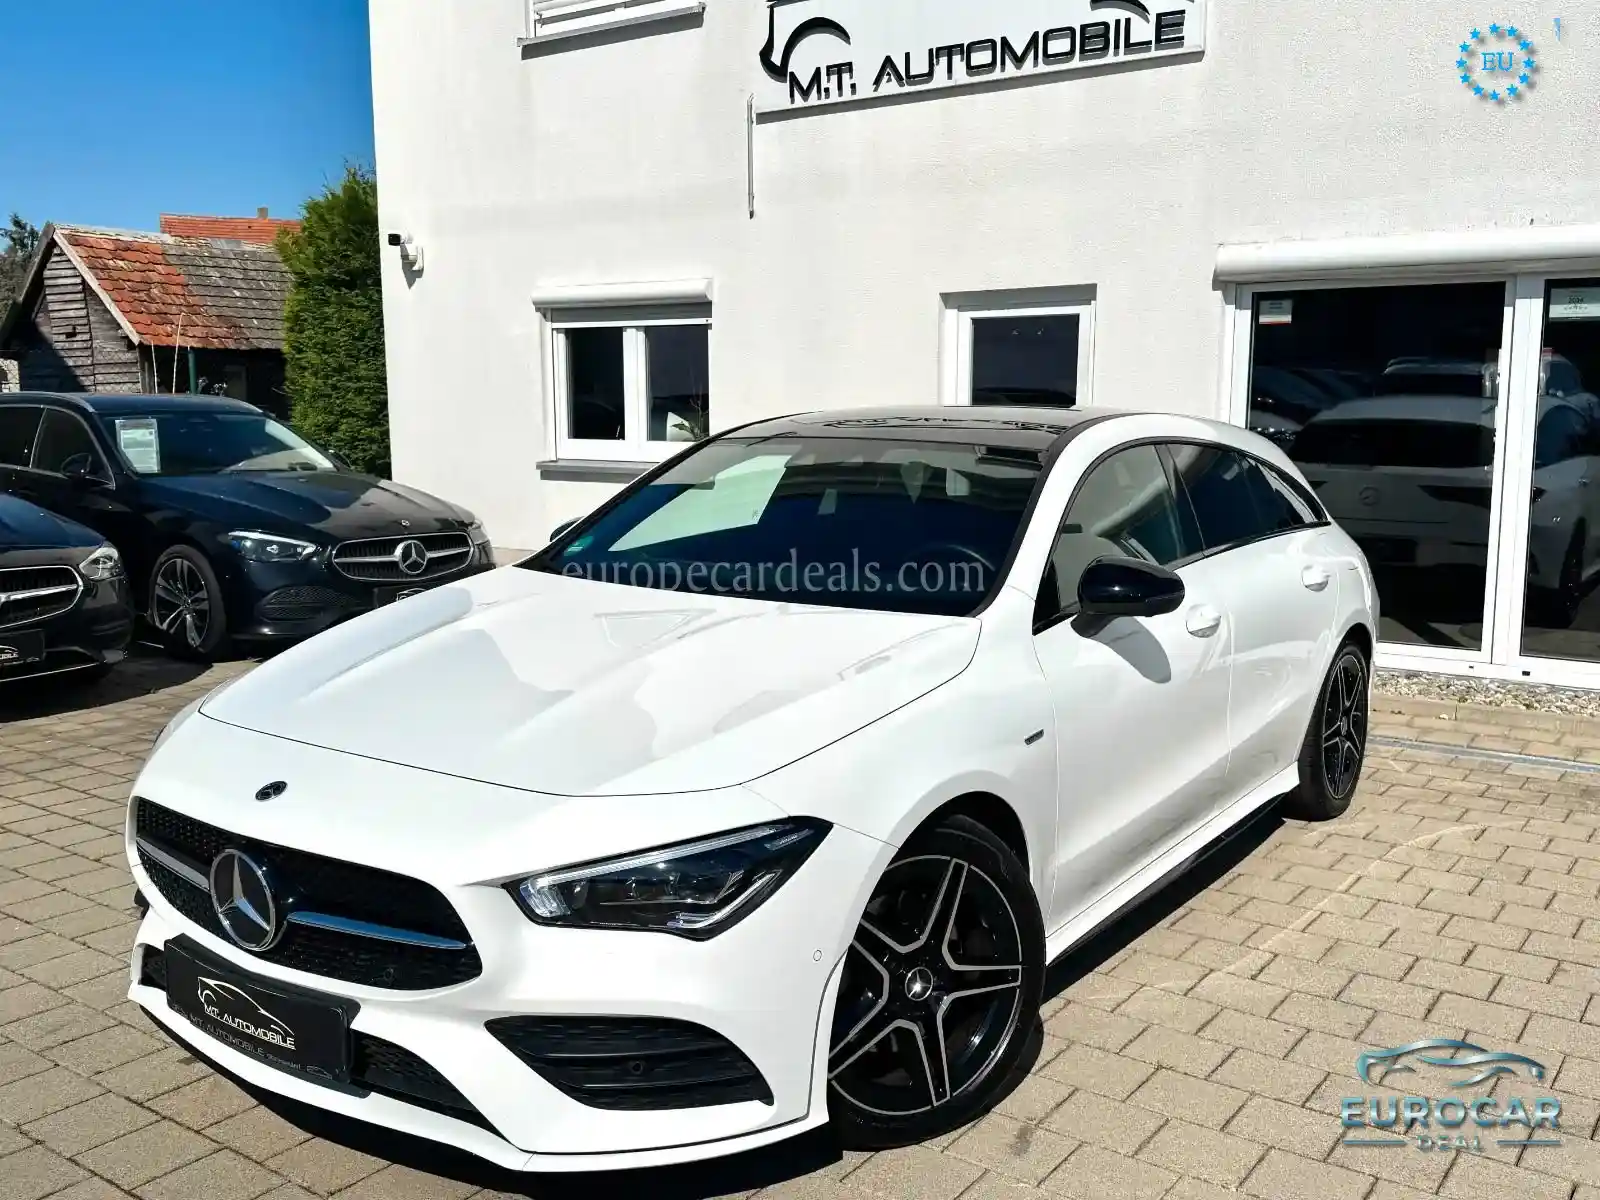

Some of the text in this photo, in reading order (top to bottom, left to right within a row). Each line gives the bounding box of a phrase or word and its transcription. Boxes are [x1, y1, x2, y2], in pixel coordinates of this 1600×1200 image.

[788, 9, 1187, 104] M.T. AUTOMOBILE
[222, 1013, 296, 1047] AUTOMOBILE
